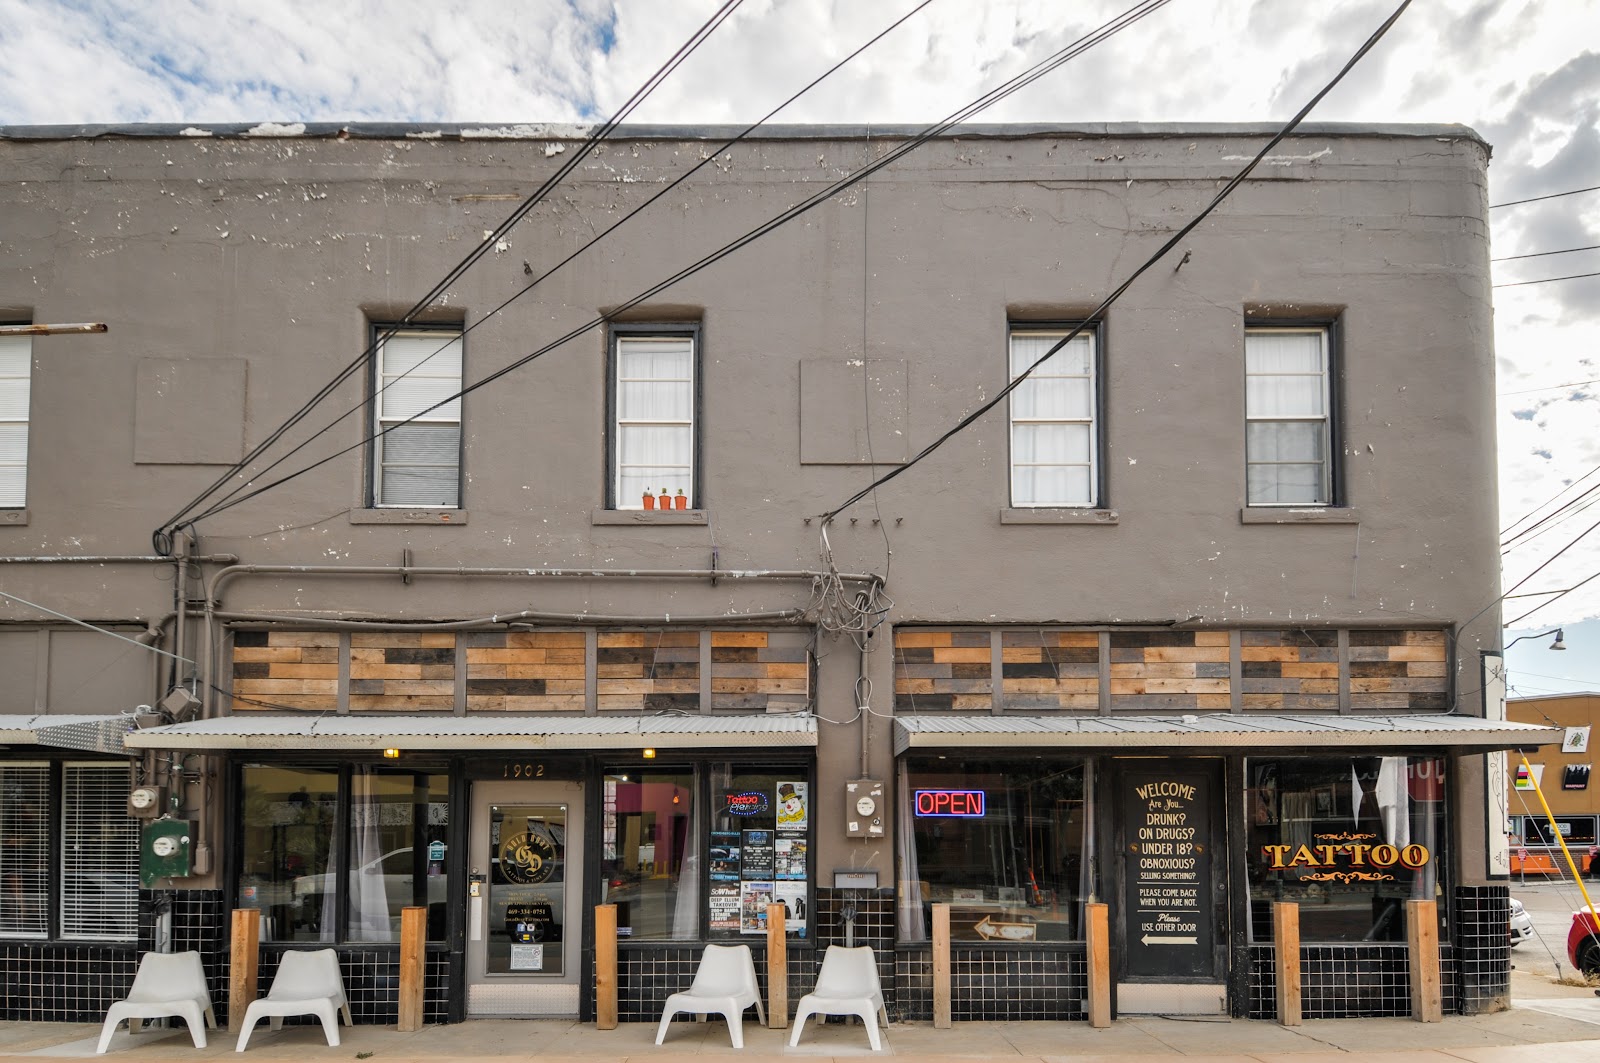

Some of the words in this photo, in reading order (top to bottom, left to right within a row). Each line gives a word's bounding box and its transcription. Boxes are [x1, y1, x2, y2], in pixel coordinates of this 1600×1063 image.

[504, 764, 544, 778] 1902
[1135, 782, 1196, 801] WELCOME
[726, 795, 758, 804] Tattoo
[918, 793, 981, 814] OPEN
[1149, 799, 1162, 812] Are
[1146, 813, 1186, 825] DRUNK?
[1139, 828, 1153, 840] ON
[1156, 828, 1195, 840] DRUGS?
[507, 835, 526, 850] GOLD
[1142, 843, 1173, 855] UNDER
[1176, 843, 1193, 855] 18?
[1262, 843, 1431, 870] TATTOO
[1140, 858, 1196, 869] OBNOXIOUS?
[1140, 872, 1161, 880] SELLING
[1163, 872, 1197, 880] SOMETHING?
[1140, 889, 1161, 897] PLEASE
[1162, 889, 1179, 897] COME
[1180, 889, 1197, 897] BACK
[1140, 898, 1156, 906] WHEN
[1158, 898, 1170, 906] YOU
[1157, 913, 1181, 922] Please
[1141, 923, 1154, 931] USE
[1155, 923, 1176, 931] OTHER
[1177, 923, 1197, 931] DOOR
